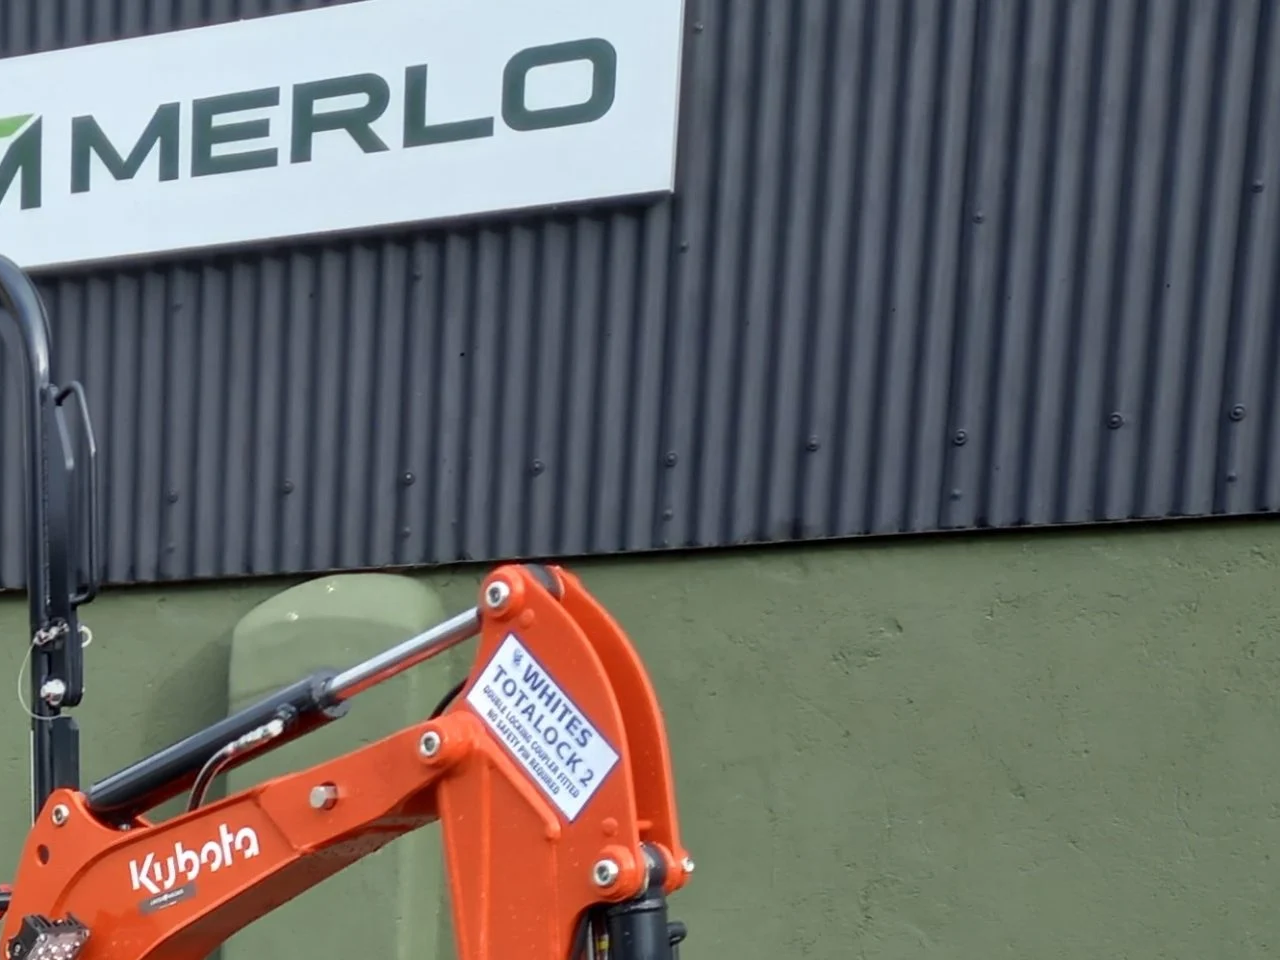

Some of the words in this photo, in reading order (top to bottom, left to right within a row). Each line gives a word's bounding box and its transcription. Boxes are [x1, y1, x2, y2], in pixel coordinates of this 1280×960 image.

[70, 37, 617, 194] MERLO
[482, 683, 507, 714] DOUBLE
[505, 710, 533, 744] LOCKING
[529, 739, 559, 775] COUPLER
[556, 770, 580, 799] FITTED
[486, 707, 498, 723] NO
[495, 718, 520, 748] SAFETY
[528, 757, 560, 796] REQUIRED
[490, 663, 583, 774] TOTALOCK
[579, 767, 595, 788] 2
[520, 662, 593, 750] WHITES
[128, 823, 260, 894] Kubota
